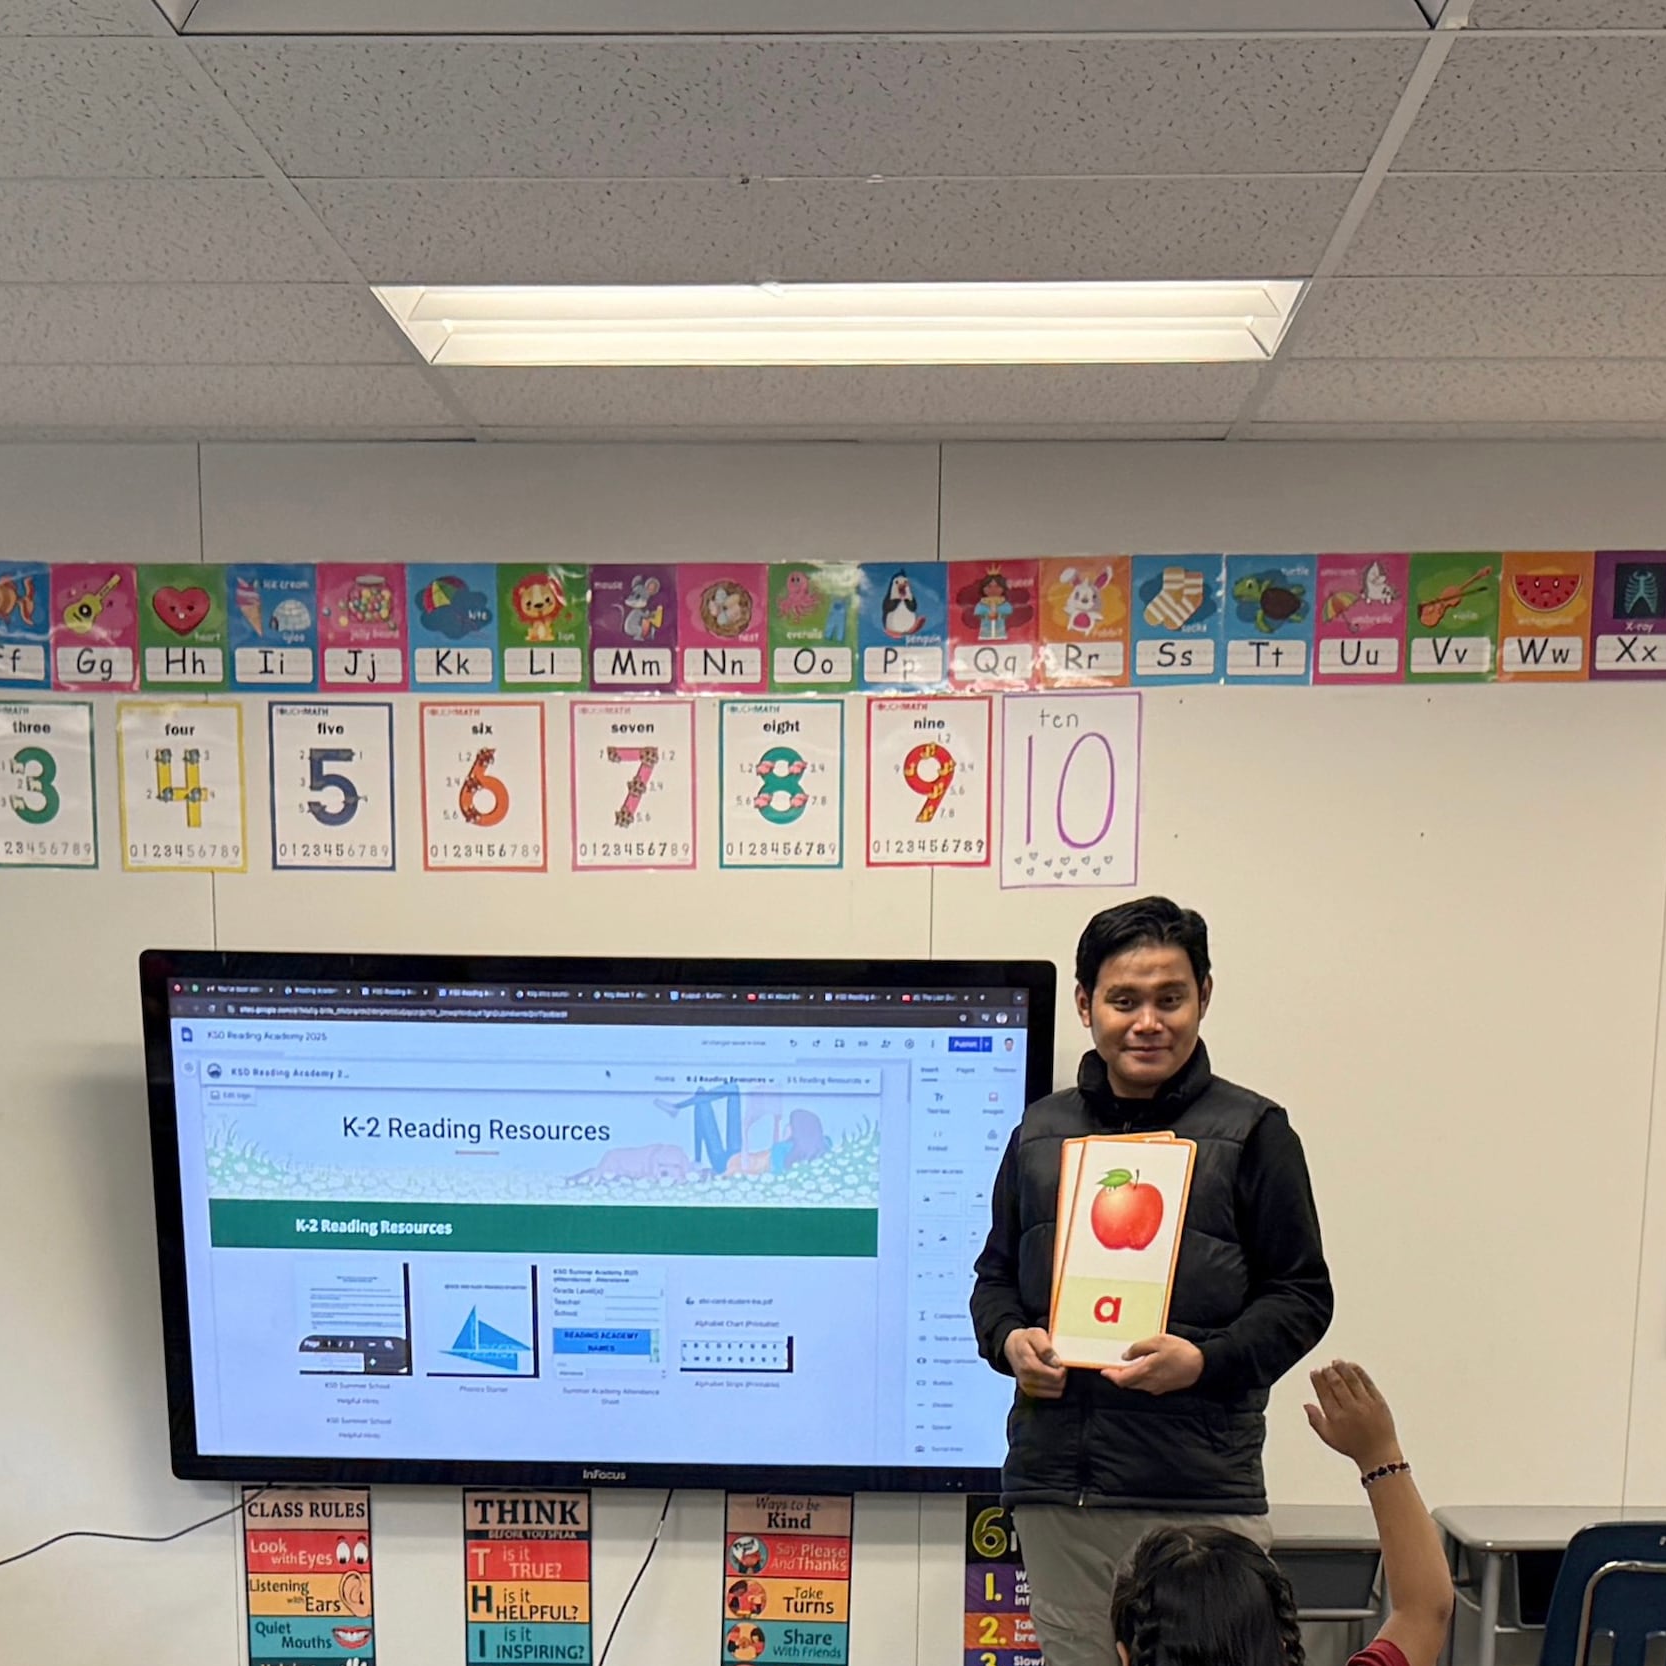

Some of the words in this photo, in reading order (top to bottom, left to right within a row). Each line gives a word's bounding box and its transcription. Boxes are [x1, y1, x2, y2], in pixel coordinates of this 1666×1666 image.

[913, 717, 945, 730] nine
[1039, 708, 1079, 729] ten
[12, 721, 52, 735] three
[164, 723, 195, 737] four
[317, 722, 344, 736] five
[471, 722, 493, 736] six
[611, 721, 655, 735] seven
[763, 720, 800, 735] eight
[10, 746, 61, 825] 3
[156, 748, 209, 828] 4
[308, 748, 360, 827] 5
[459, 746, 510, 827] 6
[608, 746, 658, 827] 7
[755, 746, 807, 825] 8
[904, 742, 956, 823] 9
[1026, 732, 1115, 849] 10
[342, 1117, 380, 1138] K-2
[388, 1118, 481, 1143] Reading
[489, 1120, 611, 1141] Resources
[295, 1218, 319, 1233] K-2
[321, 1219, 379, 1237] Reading
[380, 1219, 453, 1235] Resources
[1093, 1296, 1122, 1324] a
[583, 1469, 626, 1480] InFocus
[248, 1502, 303, 1518] CLASS
[309, 1502, 365, 1518] RULES
[474, 1499, 580, 1525] THINK
[755, 1497, 789, 1512] Ways
[791, 1498, 802, 1511] to
[805, 1497, 821, 1511] be
[766, 1512, 812, 1530] Kind
[972, 1507, 1008, 1558] 6
[250, 1538, 287, 1554] Look
[776, 1543, 798, 1558] Say
[801, 1544, 847, 1559] Please
[272, 1552, 297, 1565] with
[298, 1551, 333, 1568] Eyes
[471, 1548, 491, 1577] T
[503, 1546, 515, 1560] is
[519, 1546, 530, 1560] it
[771, 1557, 795, 1570] And
[797, 1557, 847, 1572] Thanks
[509, 1562, 562, 1578] TRUE?
[249, 1579, 309, 1596] Listening
[793, 1586, 823, 1600] Take
[305, 1597, 341, 1613] Ears
[472, 1585, 493, 1613] H
[503, 1588, 515, 1603] is
[520, 1588, 530, 1603] it
[783, 1597, 834, 1614] Turns
[496, 1605, 579, 1620] HELPFUL?
[255, 1621, 291, 1636] Quiet
[282, 1636, 332, 1649] Mouths
[478, 1630, 486, 1658] I
[504, 1627, 516, 1642] is
[520, 1627, 531, 1642] it
[783, 1629, 833, 1646] Share
[496, 1645, 585, 1659] INSPIRING?
[773, 1646, 800, 1657] With
[802, 1646, 841, 1659] Friends
